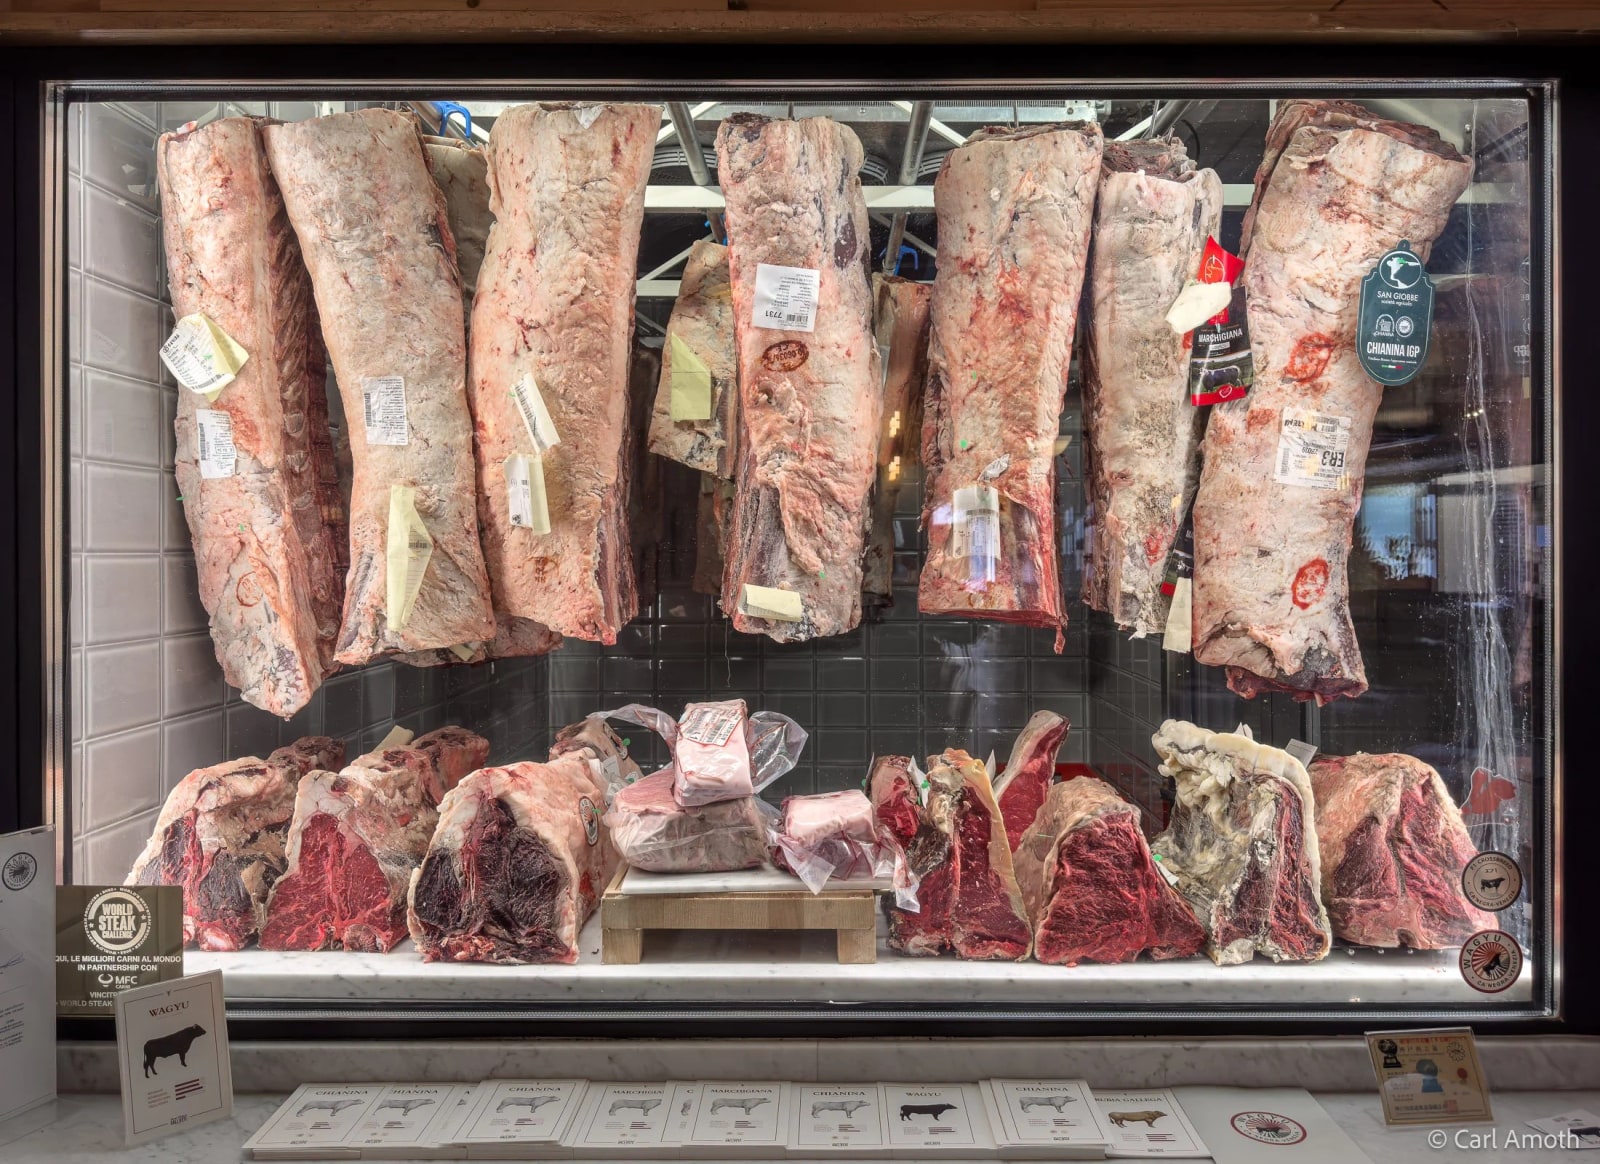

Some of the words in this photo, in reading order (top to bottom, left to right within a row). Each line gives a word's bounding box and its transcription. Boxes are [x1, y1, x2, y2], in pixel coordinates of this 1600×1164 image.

[1377, 290, 1392, 299] SAN
[1393, 292, 1419, 302] GIOBBE
[765, 310, 783, 319] 7731
[1198, 328, 1243, 343] MARCHIGIANA
[1366, 341, 1406, 357] CHIANINA
[1406, 345, 1420, 358] IGP
[1321, 450, 1345, 468] ER3
[102, 903, 133, 916] WORLD
[98, 915, 136, 931] STEAK
[102, 930, 133, 939] CHALLENGE
[1463, 934, 1501, 970] WAGYU
[82, 955, 116, 963] MIGLIORI
[117, 955, 140, 963] CARNI
[142, 955, 152, 963] AL
[153, 955, 182, 963] MONDO
[87, 964, 139, 972] PARTNERSHIP
[115, 976, 138, 984] MFC
[149, 1001, 190, 1017] WAGYU
